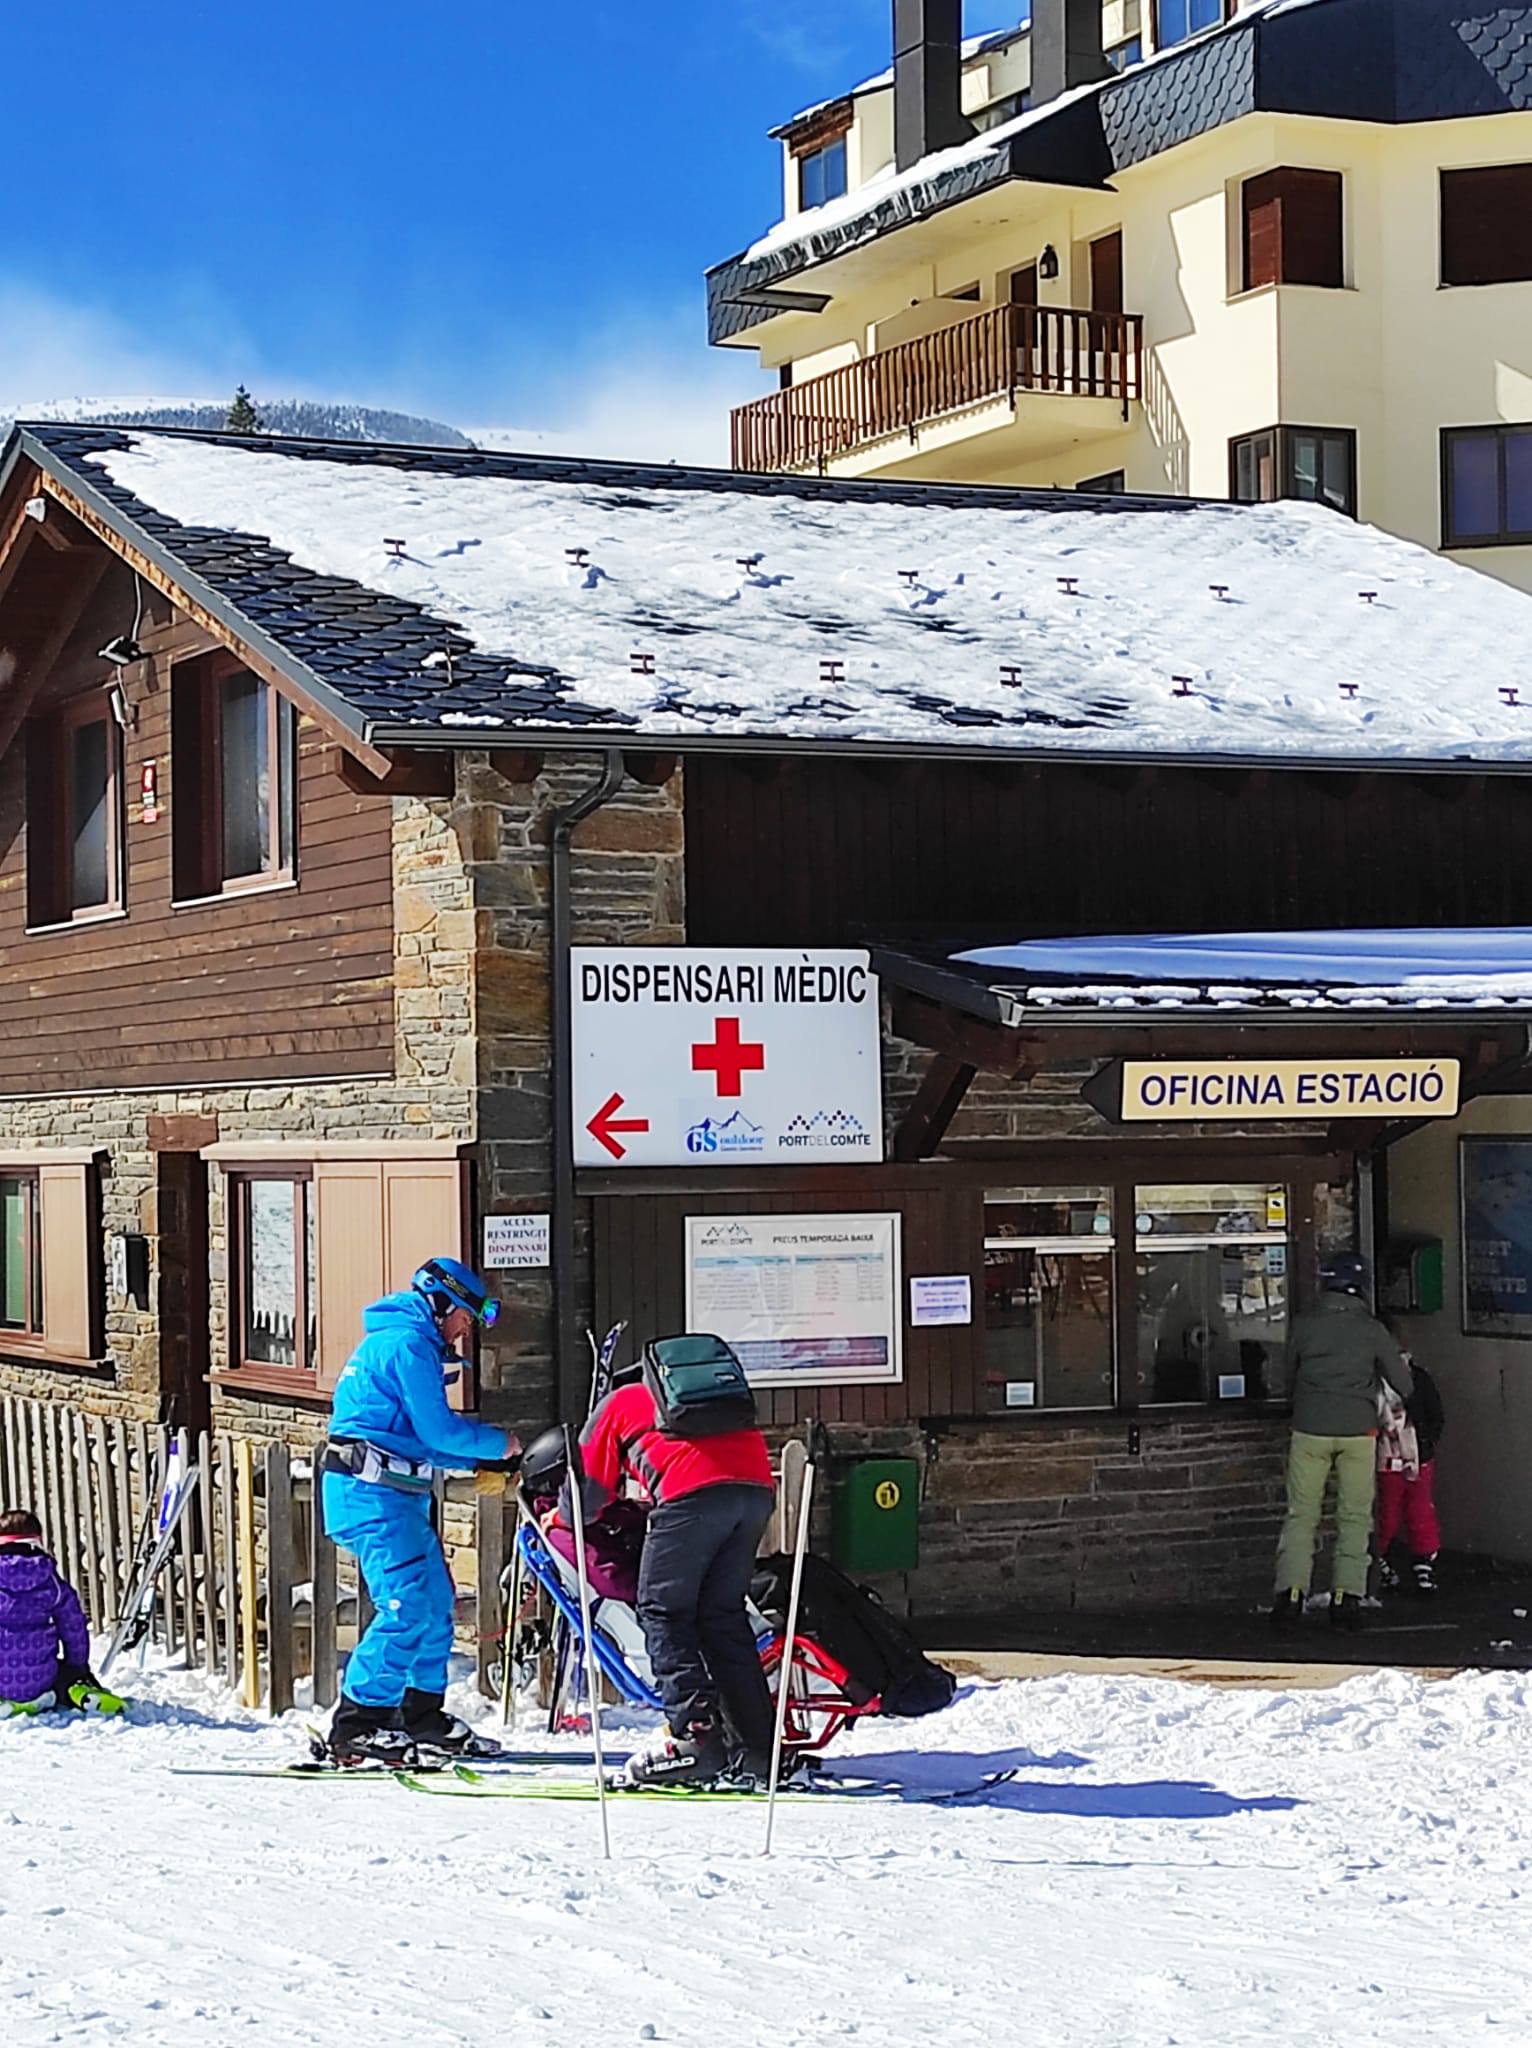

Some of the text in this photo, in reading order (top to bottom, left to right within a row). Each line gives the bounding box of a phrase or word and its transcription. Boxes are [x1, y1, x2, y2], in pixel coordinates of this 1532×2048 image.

[581, 953, 867, 1003] DISPENSARI MÈDIC
[1140, 1064, 1444, 1106] OFICINA ESTACIÓ
[686, 1131, 765, 1153] GS outdoor
[487, 1228, 547, 1239] RESTRINGIT
[488, 1243, 547, 1253] DISPENSARI
[493, 1256, 542, 1265] OFICINES
[645, 1756, 696, 1775] HEAD
